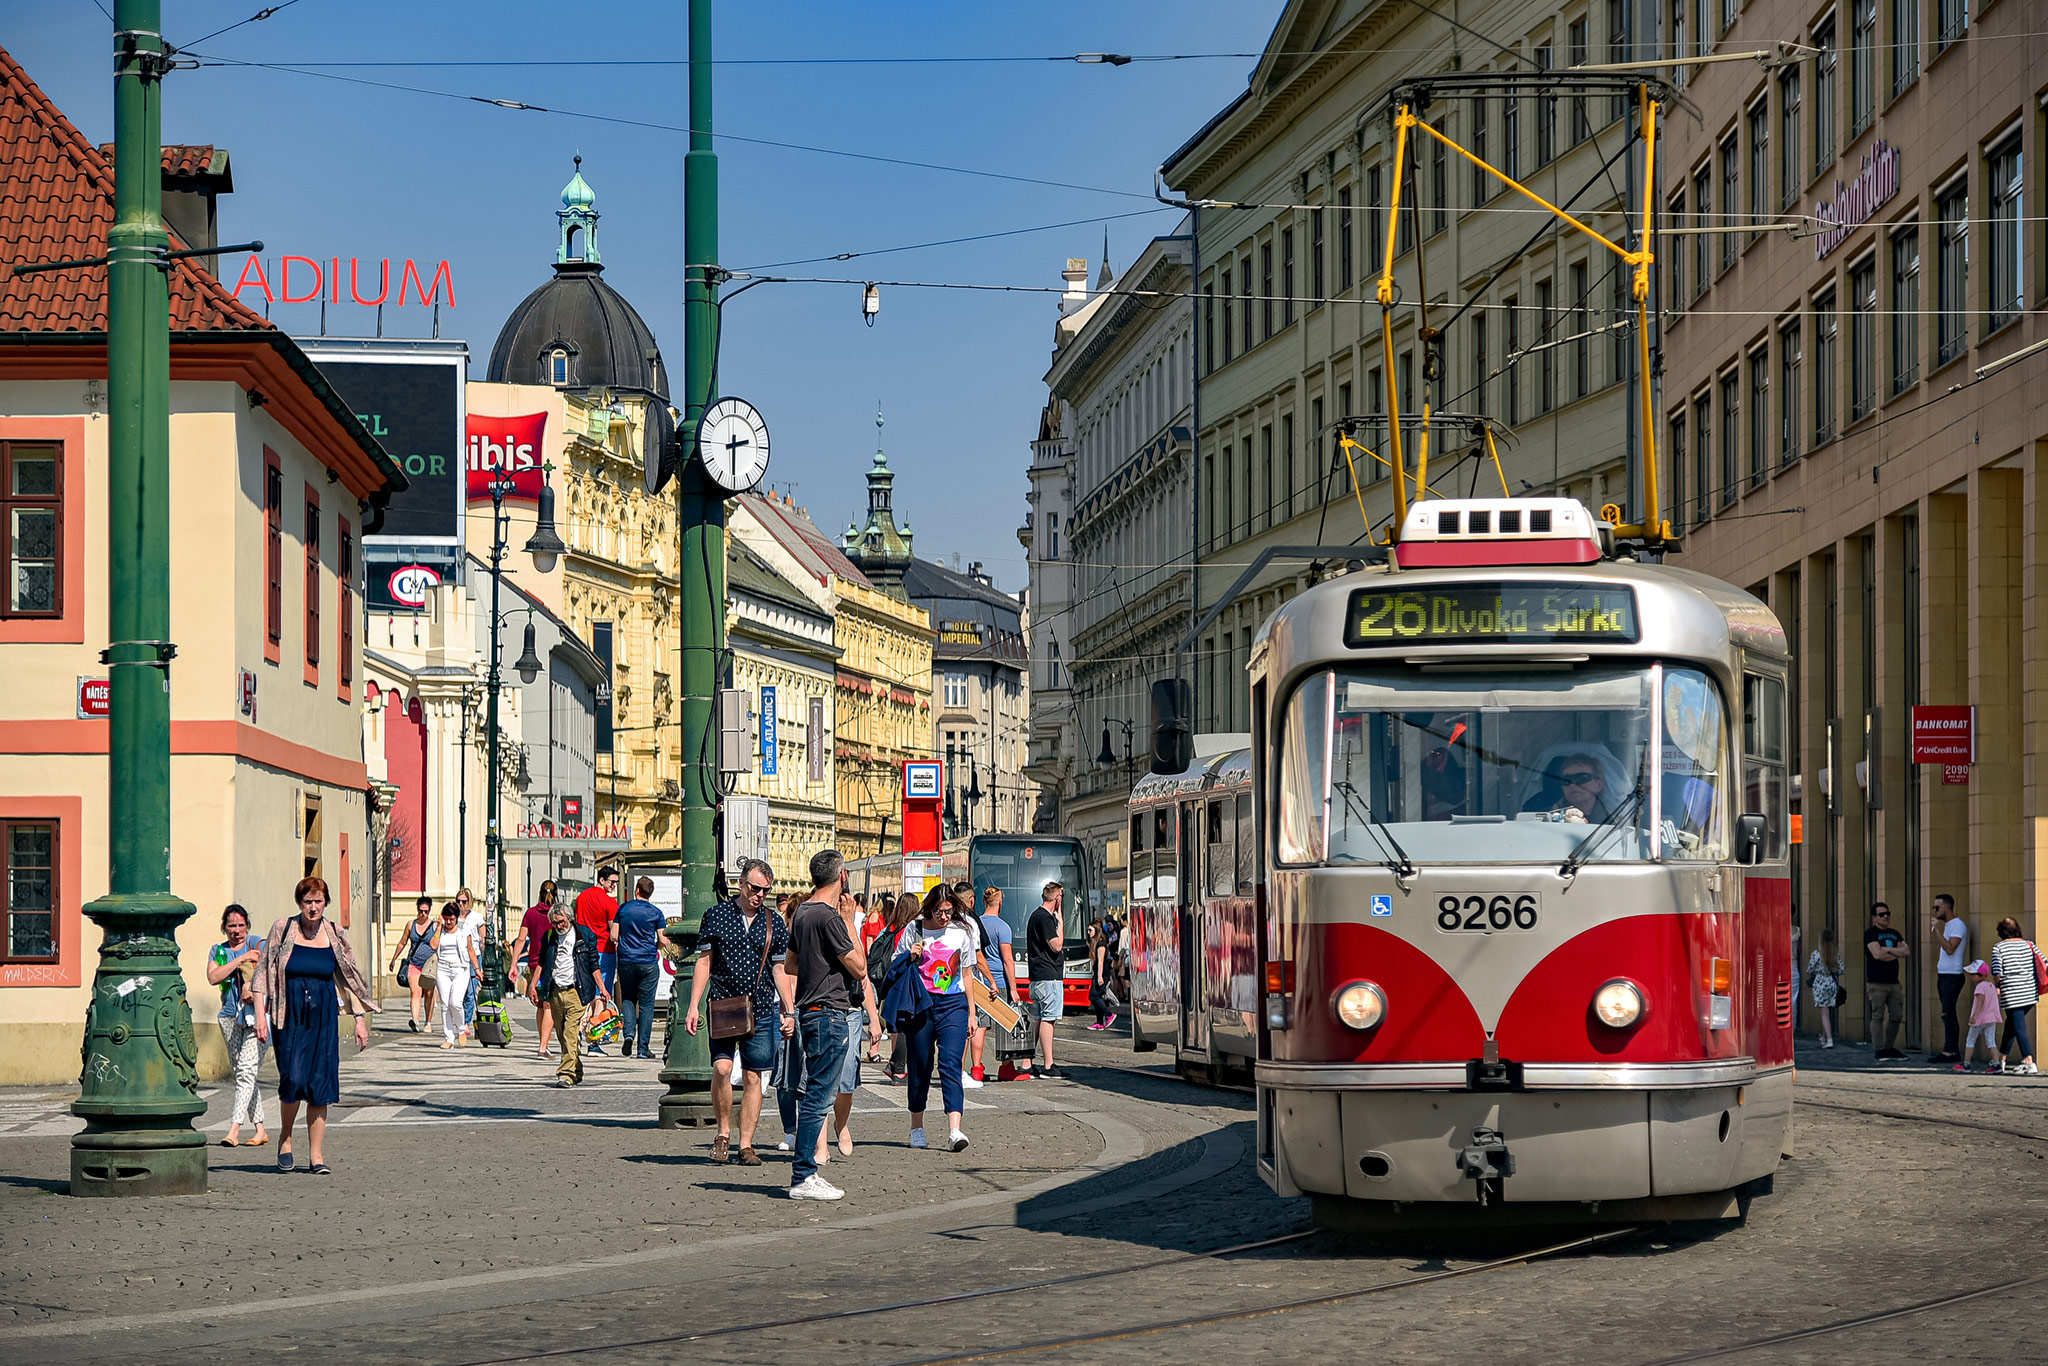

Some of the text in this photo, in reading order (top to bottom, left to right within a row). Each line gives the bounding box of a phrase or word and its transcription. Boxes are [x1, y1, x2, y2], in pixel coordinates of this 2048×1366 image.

[232, 254, 456, 308] ADIUM
[470, 435, 534, 471] ibis
[389, 454, 447, 476] OR
[1360, 591, 1427, 637] 26
[1432, 596, 1528, 633] Divoká
[940, 632, 982, 645] IMPERIAL
[763, 697, 775, 743] ATLANTIC
[1916, 720, 1968, 729] BANKOMAT
[1923, 746, 1969, 754] UniCredit Bank
[1945, 765, 1969, 775] 2090
[516, 823, 628, 839] PALLADIUM
[1024, 846, 1034, 860] 8
[1438, 895, 1538, 930] 8266
